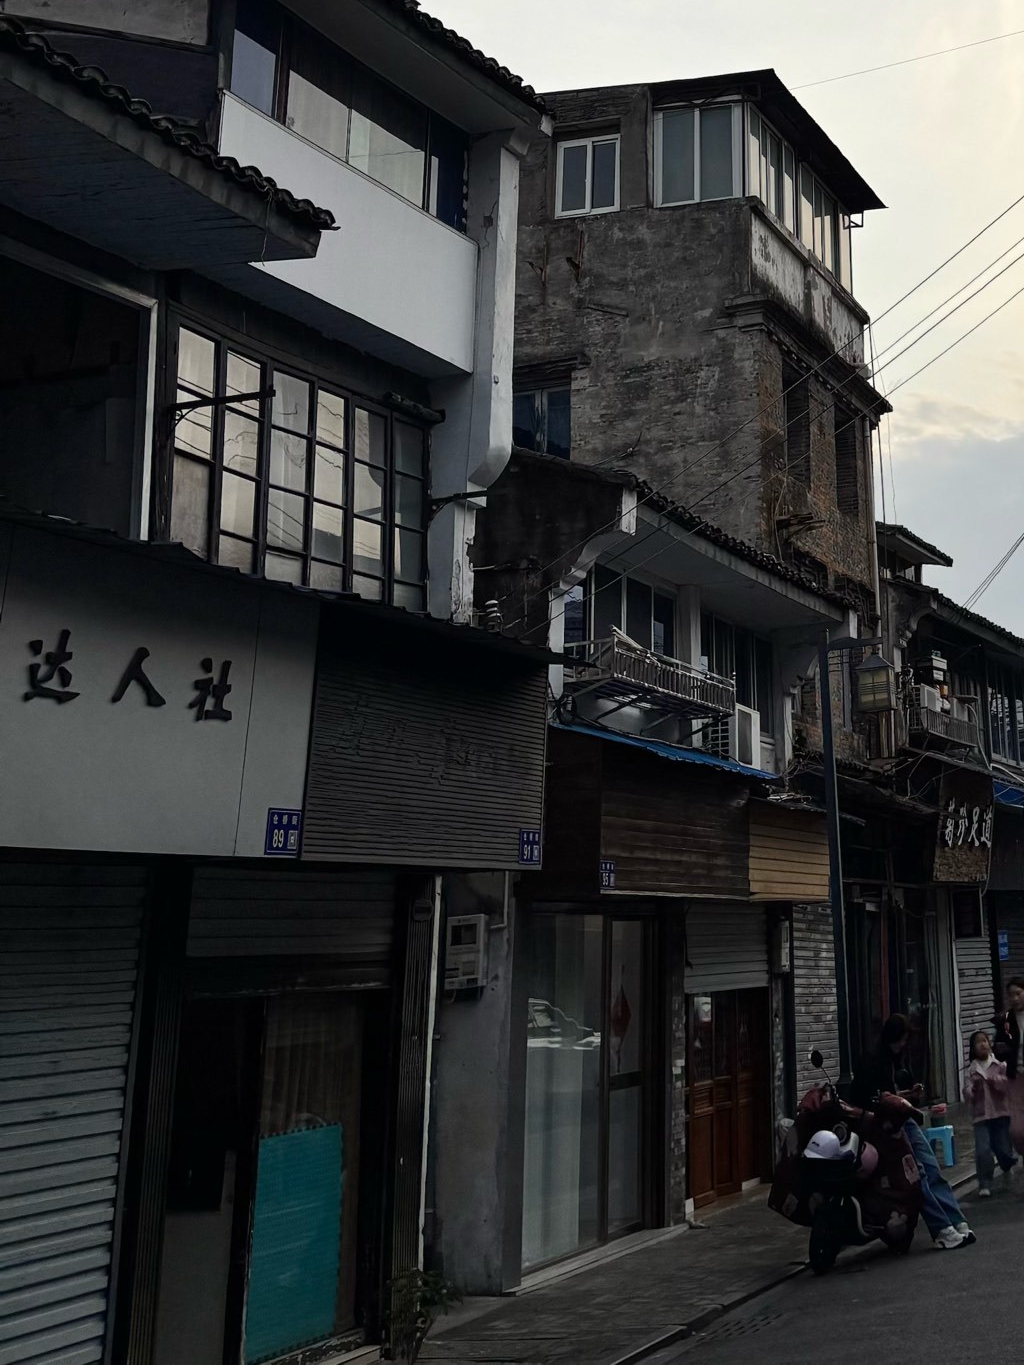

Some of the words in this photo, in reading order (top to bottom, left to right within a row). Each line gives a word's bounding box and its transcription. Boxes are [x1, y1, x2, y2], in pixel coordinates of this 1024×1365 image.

[23, 629, 233, 722] 达人社
[272, 828, 285, 848] 89
[523, 844, 531, 860] 91
